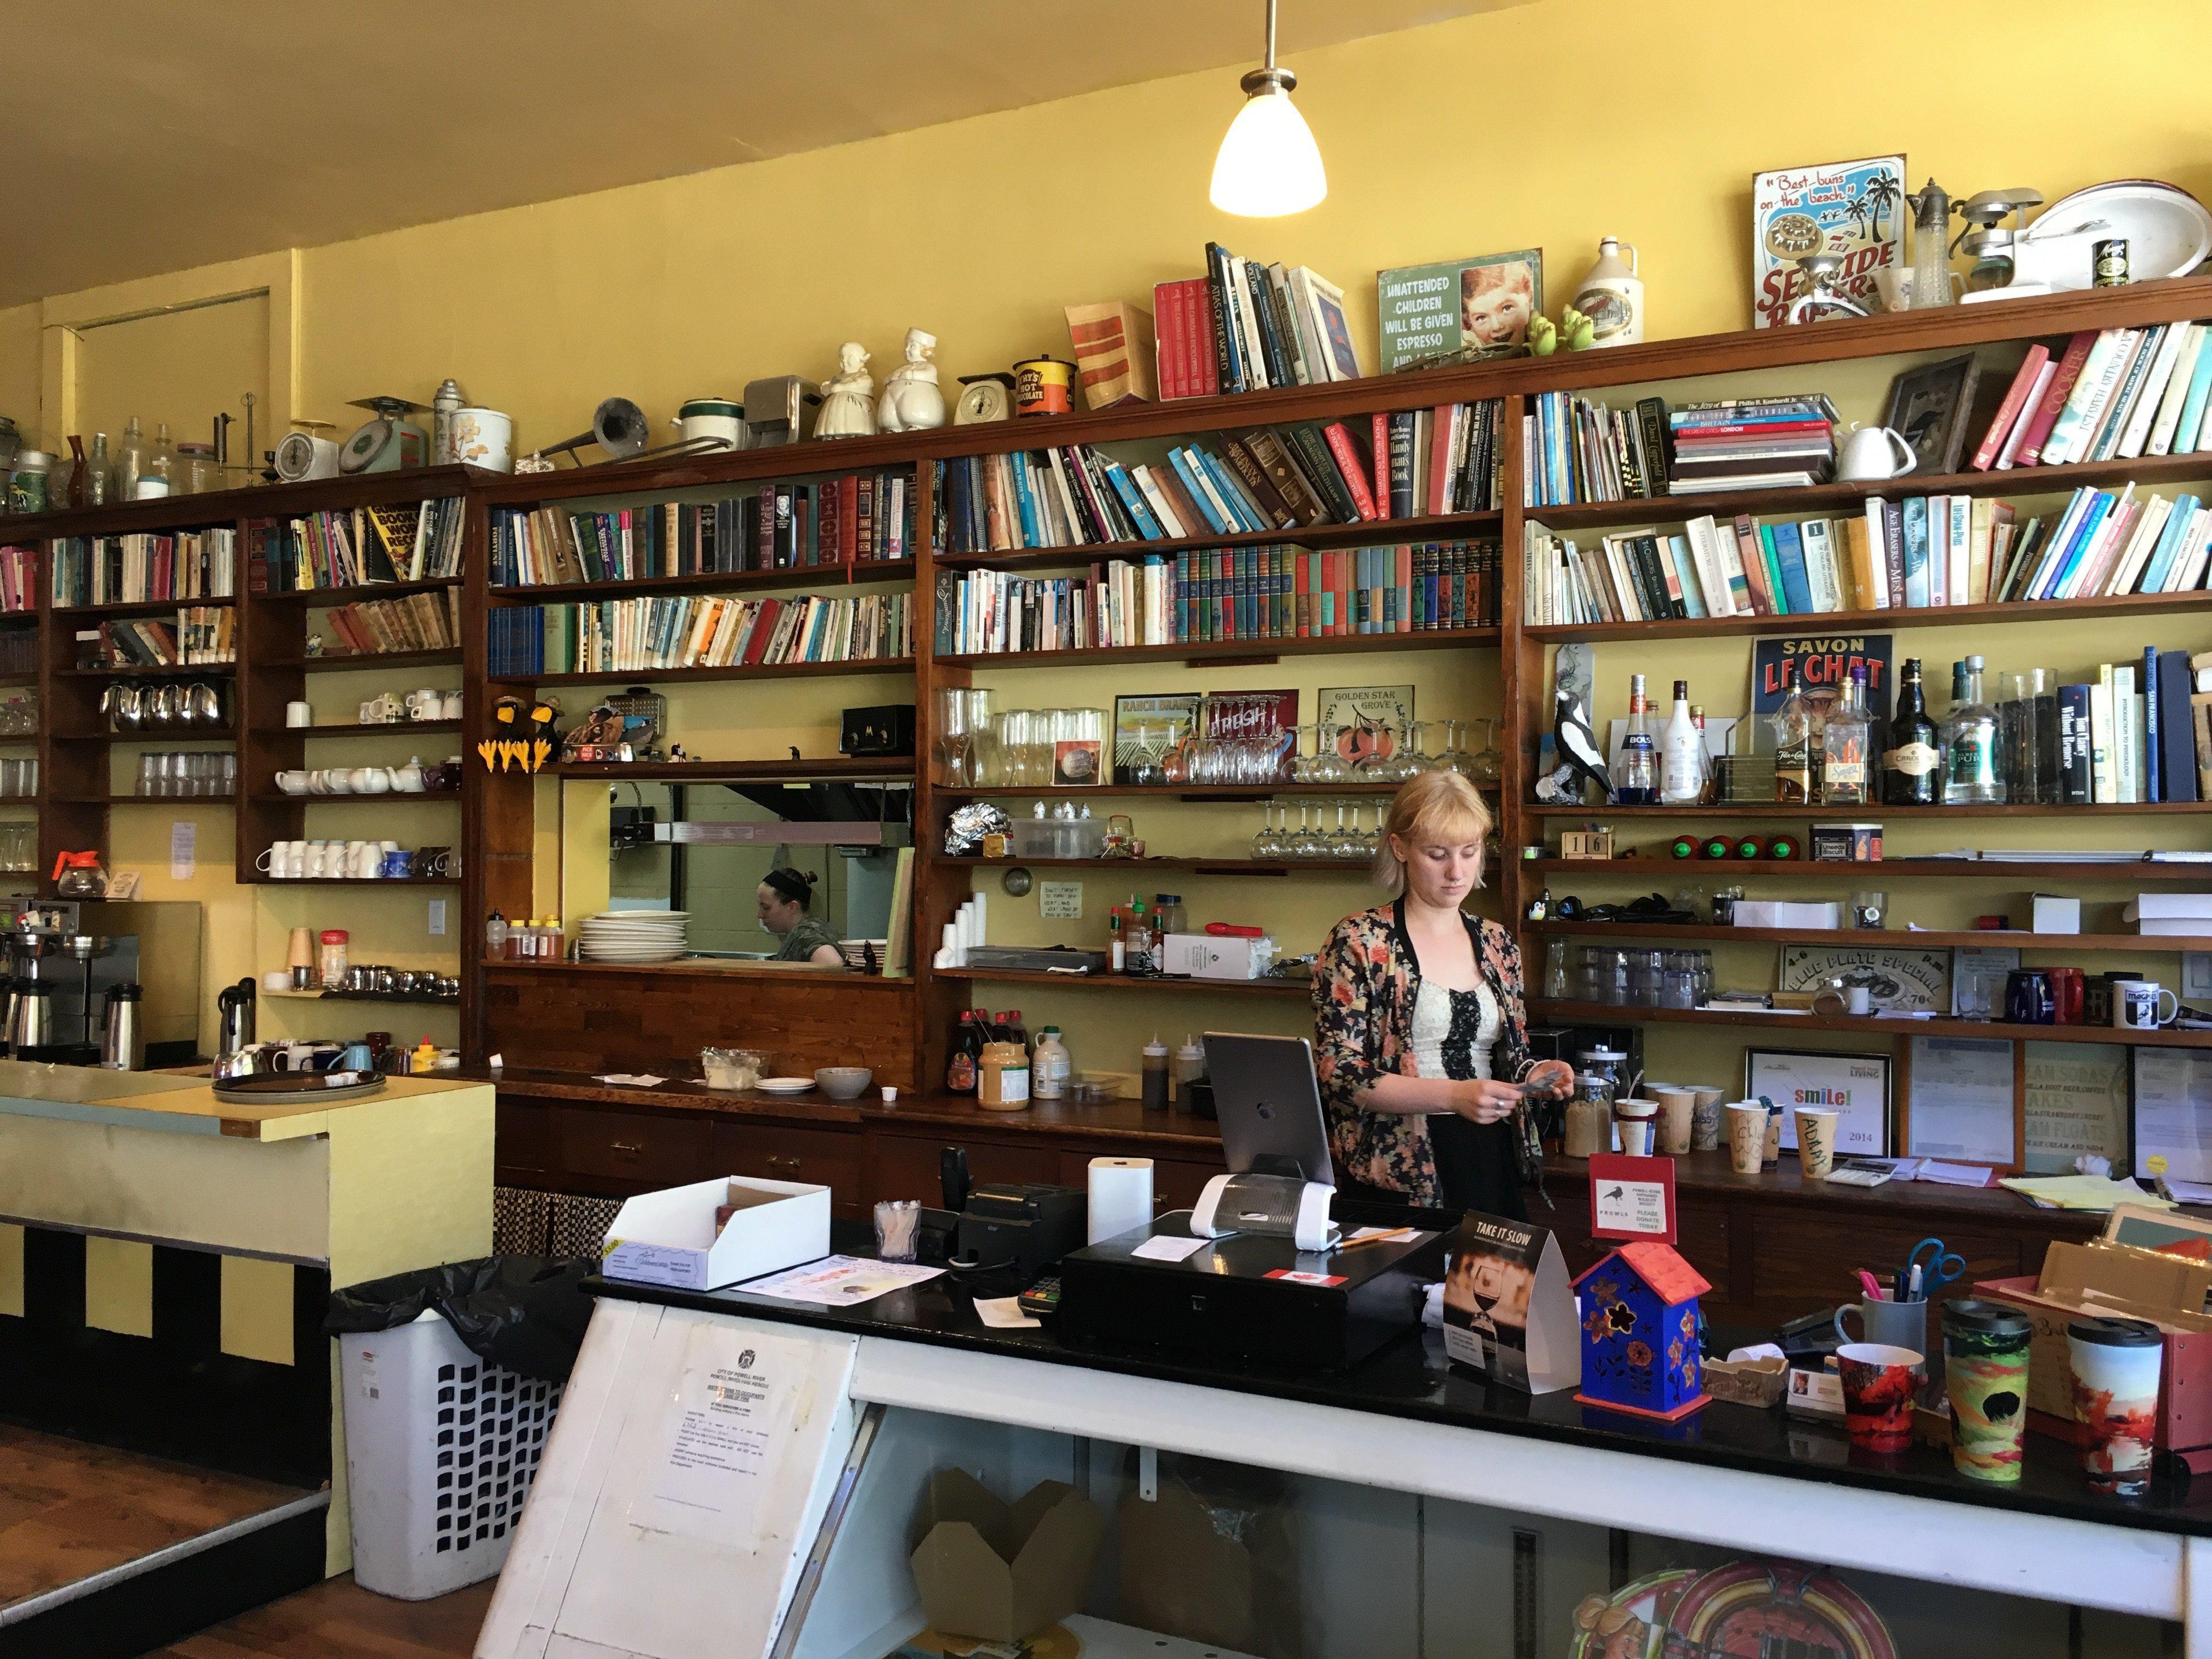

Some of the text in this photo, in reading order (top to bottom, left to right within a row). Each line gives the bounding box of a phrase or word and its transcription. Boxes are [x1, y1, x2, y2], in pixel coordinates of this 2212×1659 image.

[1817, 171, 1844, 187] buns
[1759, 201, 1774, 210] on
[1781, 194, 1800, 207] the
[1245, 260, 1257, 295] HOLLAND
[1757, 240, 1898, 312] SEIDE
[1387, 276, 1449, 297] UNATTENDED
[1396, 296, 1442, 314] CHILDREN
[1210, 284, 1228, 371] ATLAS OF THE WORLD
[1385, 313, 1453, 334] WILL BE GIVEN
[1397, 333, 1443, 351] ESPRESSO
[2143, 336, 2152, 347] THE
[2099, 341, 2129, 388] COUNTRY
[2136, 347, 2148, 365] BOOK
[1020, 372, 1039, 383] FRY'S
[2124, 374, 2136, 394] WHOLE
[1020, 383, 1037, 393] HOT
[2078, 386, 2108, 433] HARVEST
[2115, 394, 2128, 414] MEALS
[1392, 469, 1409, 482] Book
[1812, 525, 1819, 535] 1
[1700, 530, 1712, 567] LITERATURE
[1891, 569, 1901, 592] MEN
[936, 588, 950, 635] Soundtracks
[1783, 638, 1865, 654] SAVON
[1335, 691, 1396, 701] GOLDEN STAR
[1361, 701, 1391, 709] GROVE
[1122, 699, 1155, 712] RANCH
[2061, 706, 2075, 769] Without Remorse
[2074, 716, 2090, 757] Tom Clancy
[1573, 836, 1600, 852] 1 6
[1788, 962, 1824, 991] BLUE
[1826, 952, 1876, 969] PLATE
[1882, 956, 1942, 997] SPECIAL
[1850, 1070, 1879, 1078] LIVING
[1849, 1132, 1872, 1142] 2014
[1476, 1222, 1498, 1237] TAKE
[1497, 1227, 1508, 1239] IT
[1506, 1230, 1532, 1246] SLOW
